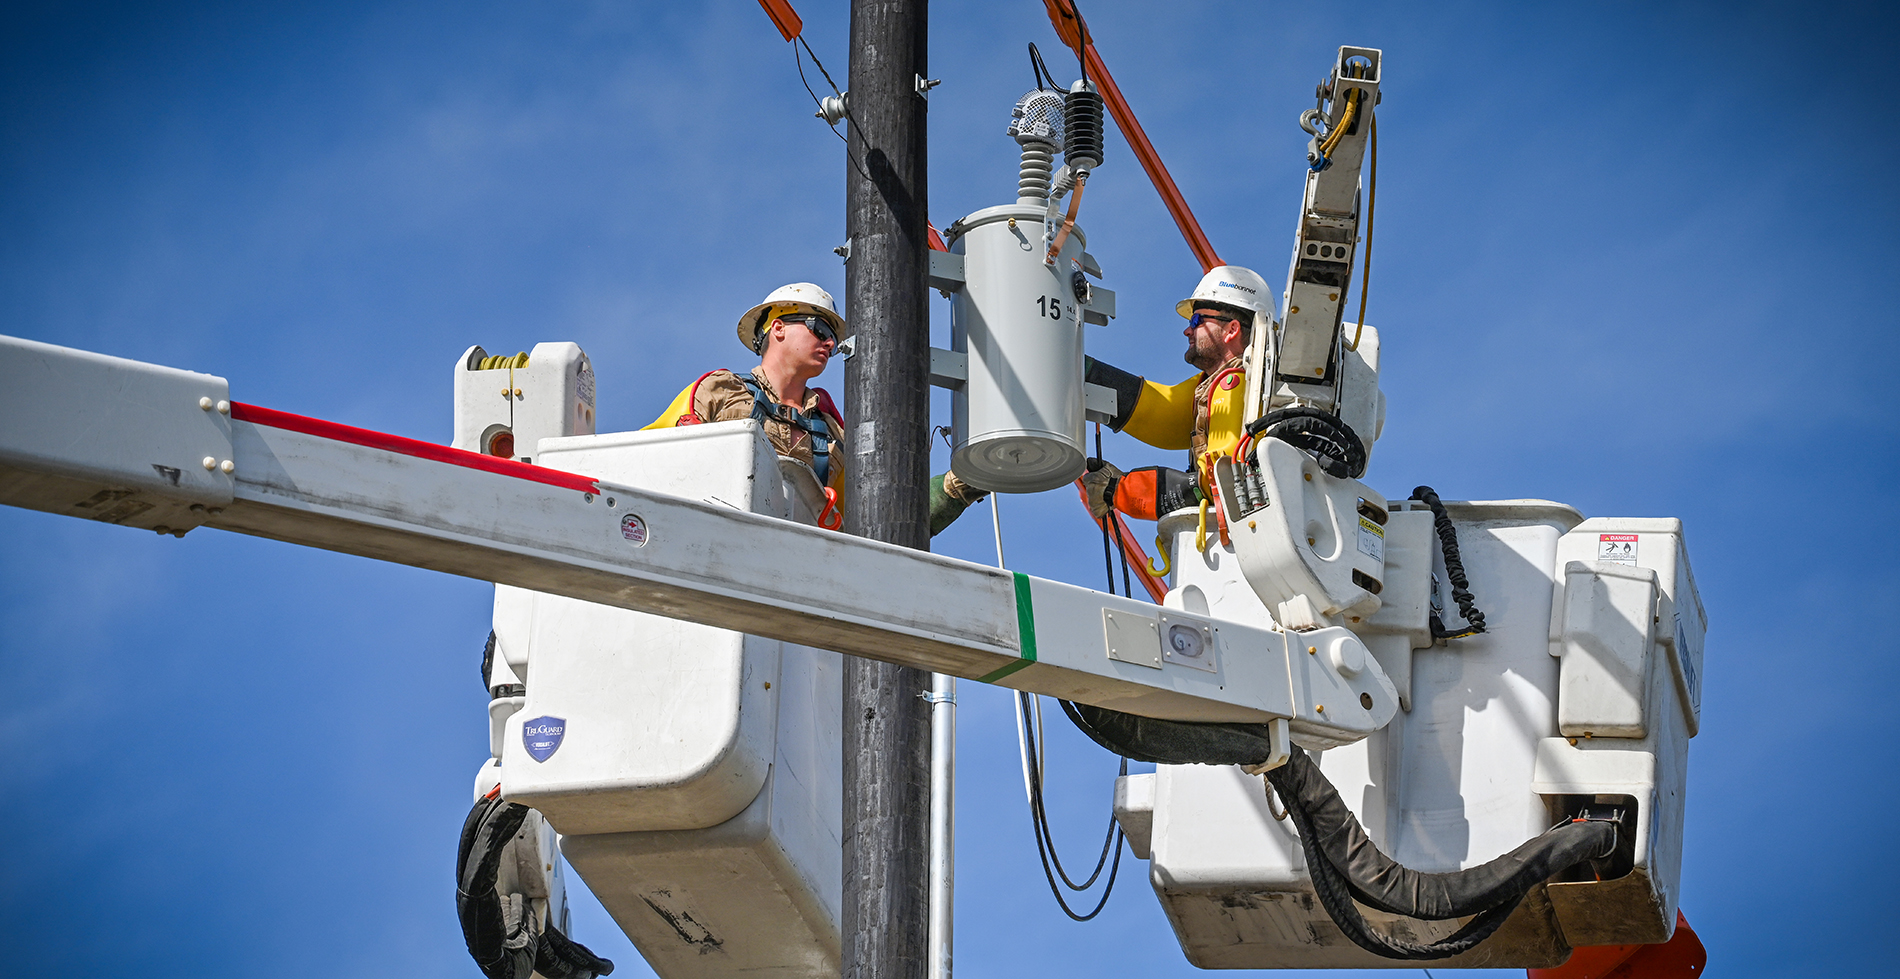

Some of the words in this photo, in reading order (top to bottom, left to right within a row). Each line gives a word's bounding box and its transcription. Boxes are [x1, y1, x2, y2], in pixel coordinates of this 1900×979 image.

[1218, 280, 1257, 295] Bluebonnet
[1036, 294, 1061, 321] 15
[625, 532, 643, 540] SECTION
[1365, 520, 1385, 537] CAUTION
